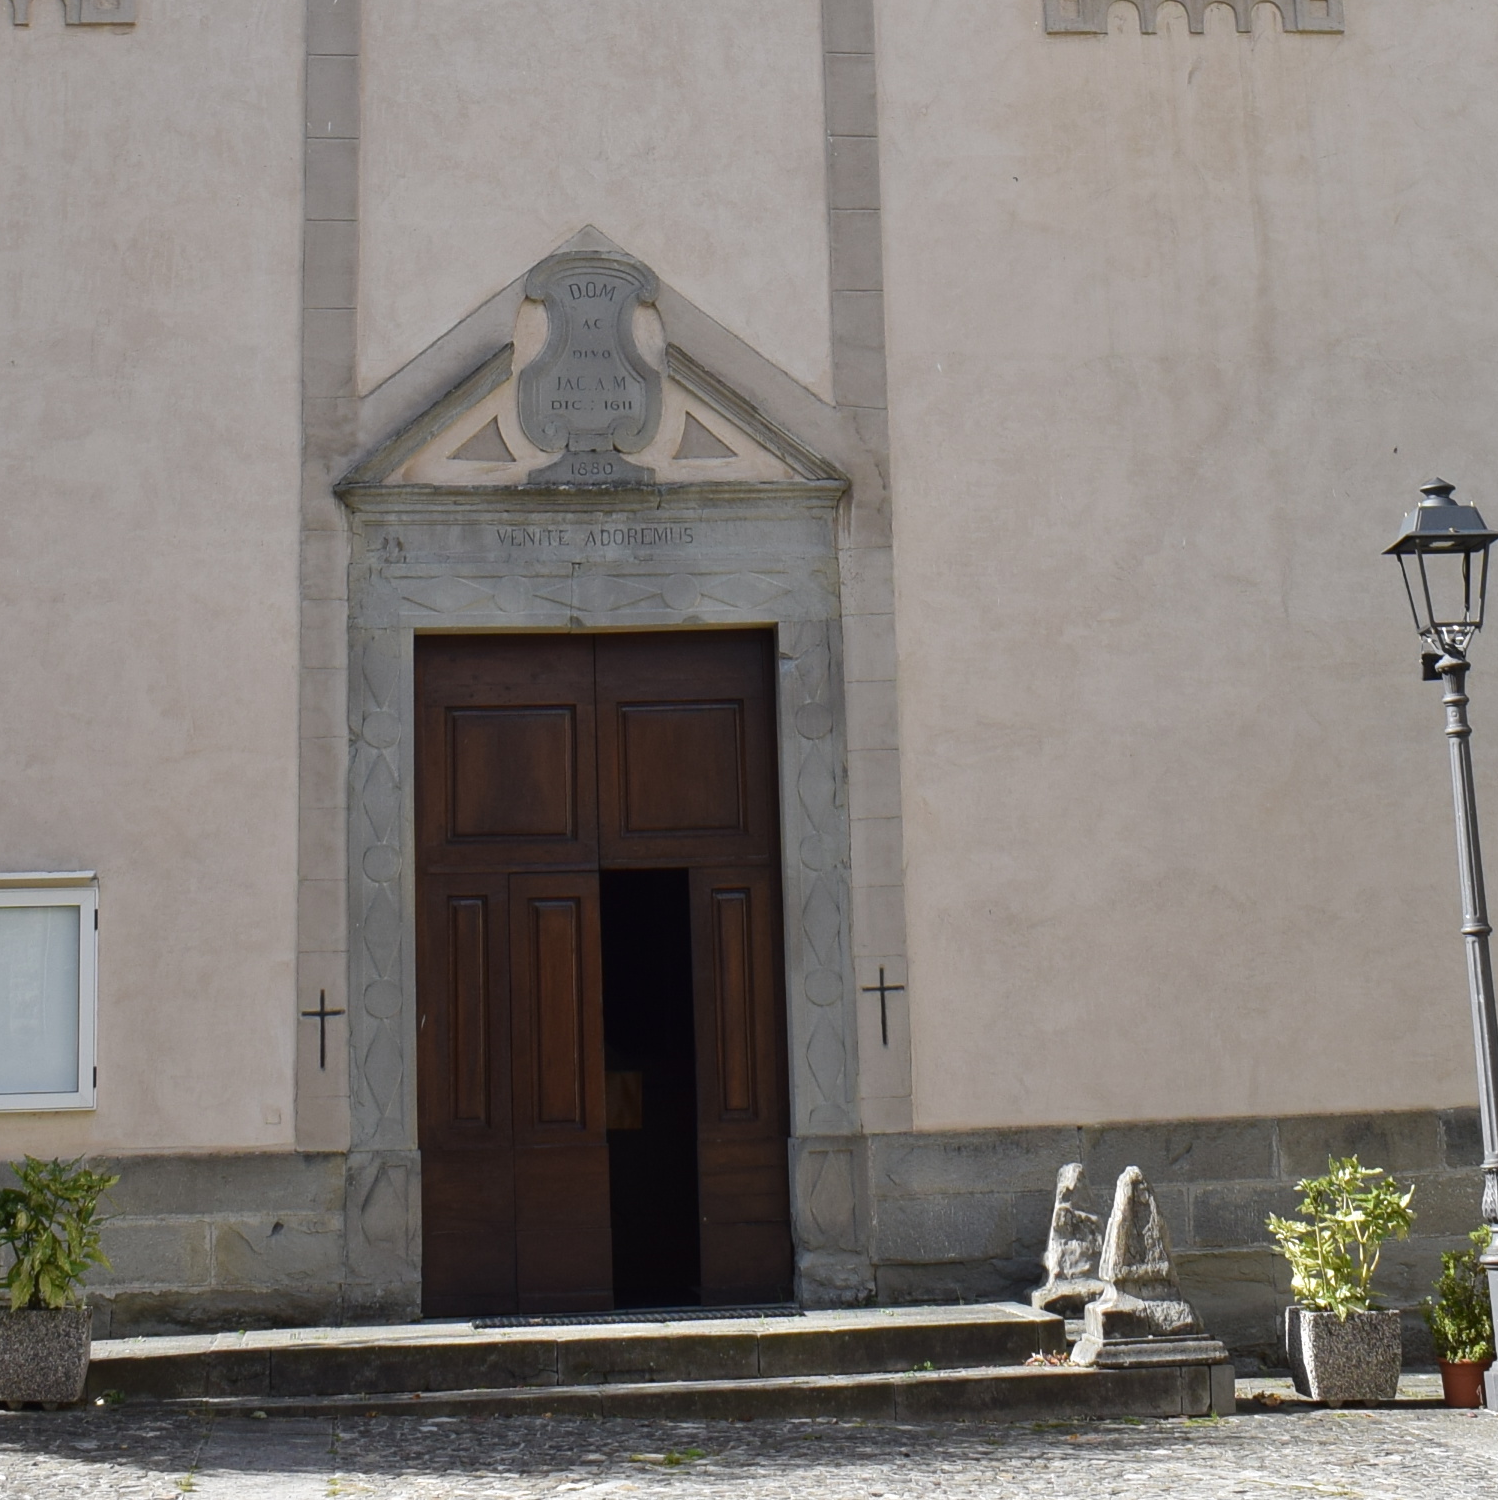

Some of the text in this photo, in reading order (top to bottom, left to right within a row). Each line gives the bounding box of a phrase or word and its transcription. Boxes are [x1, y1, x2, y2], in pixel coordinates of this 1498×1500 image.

[573, 349, 611, 359] DIVO
[604, 400, 633, 410] 1611
[570, 462, 614, 476] 1880
[496, 527, 694, 547] VENITE ADOREMUS
